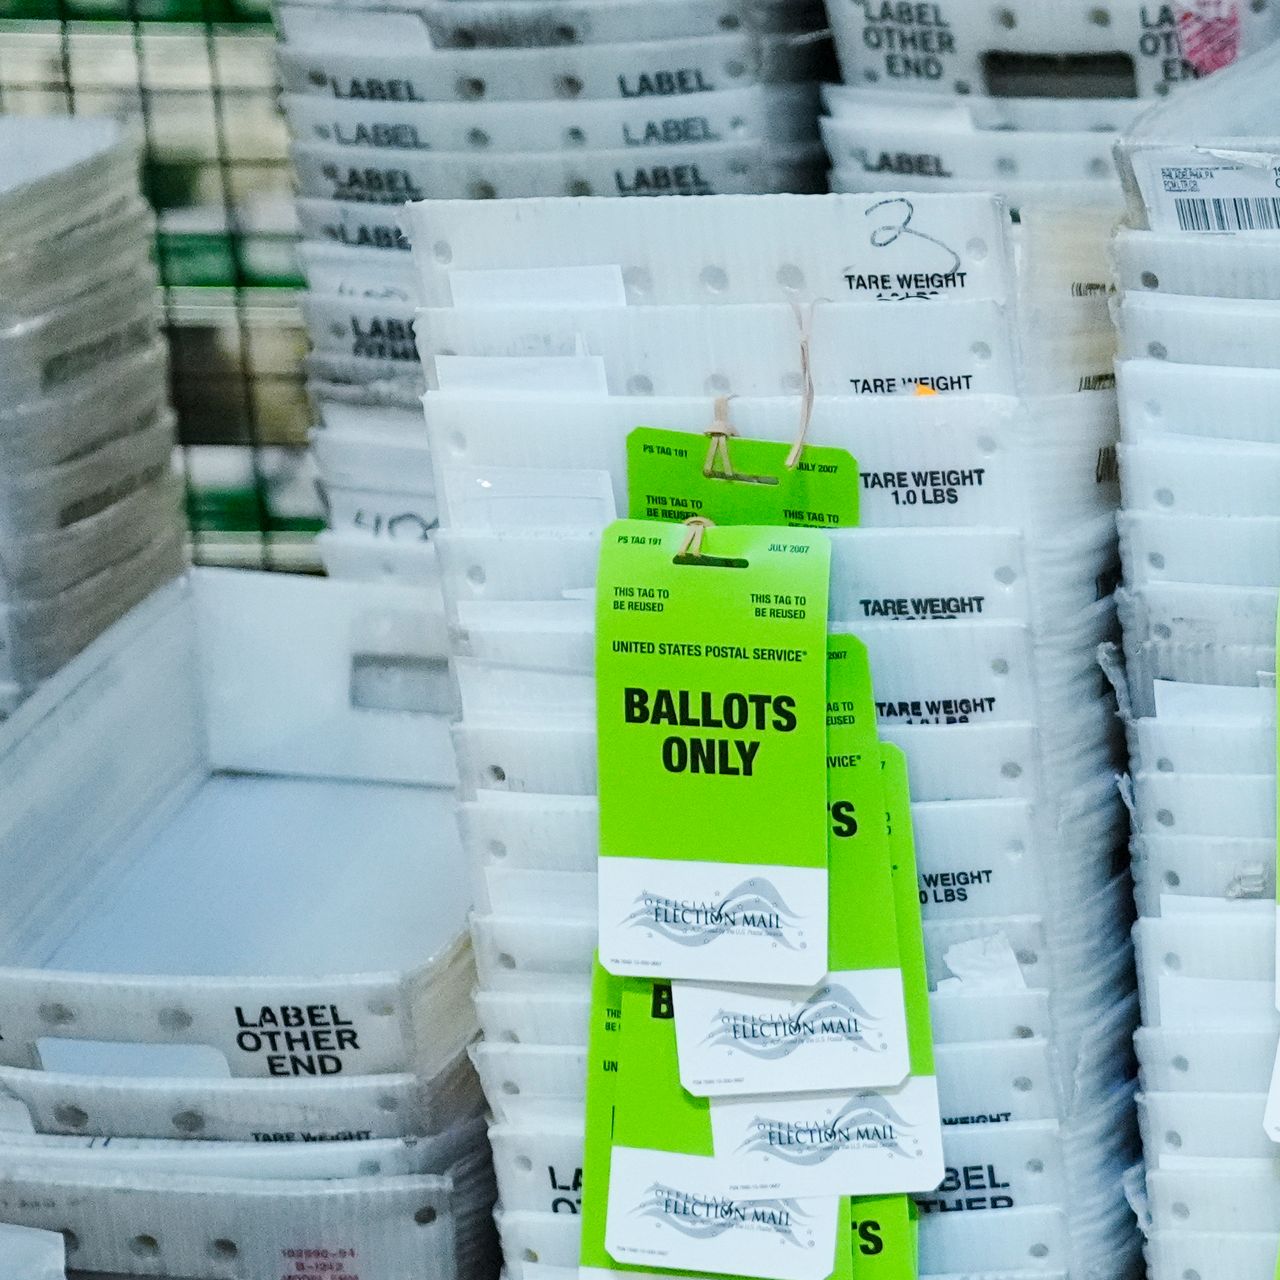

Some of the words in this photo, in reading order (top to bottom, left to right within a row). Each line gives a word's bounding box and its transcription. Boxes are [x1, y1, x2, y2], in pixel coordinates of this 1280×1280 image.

[863, 26, 954, 54] OTHER
[885, 51, 944, 80] END
[618, 68, 713, 98] LABEL
[623, 117, 719, 146] LABEL
[860, 472, 908, 488] TARE
[911, 469, 984, 487] WEIGHT
[892, 490, 917, 505] 1.0
[922, 488, 958, 504] LBS
[613, 641, 655, 654] UNITED
[659, 643, 701, 656] STATES
[705, 646, 749, 659] POSTAL
[625, 688, 796, 732] BALLOTS
[663, 737, 760, 776] ONLY
[654, 902, 737, 930] ELECTION
[741, 908, 784, 930] MAIL
[235, 1005, 352, 1028] LABEL
[237, 1029, 359, 1052] OTHER
[267, 1054, 342, 1077] END
